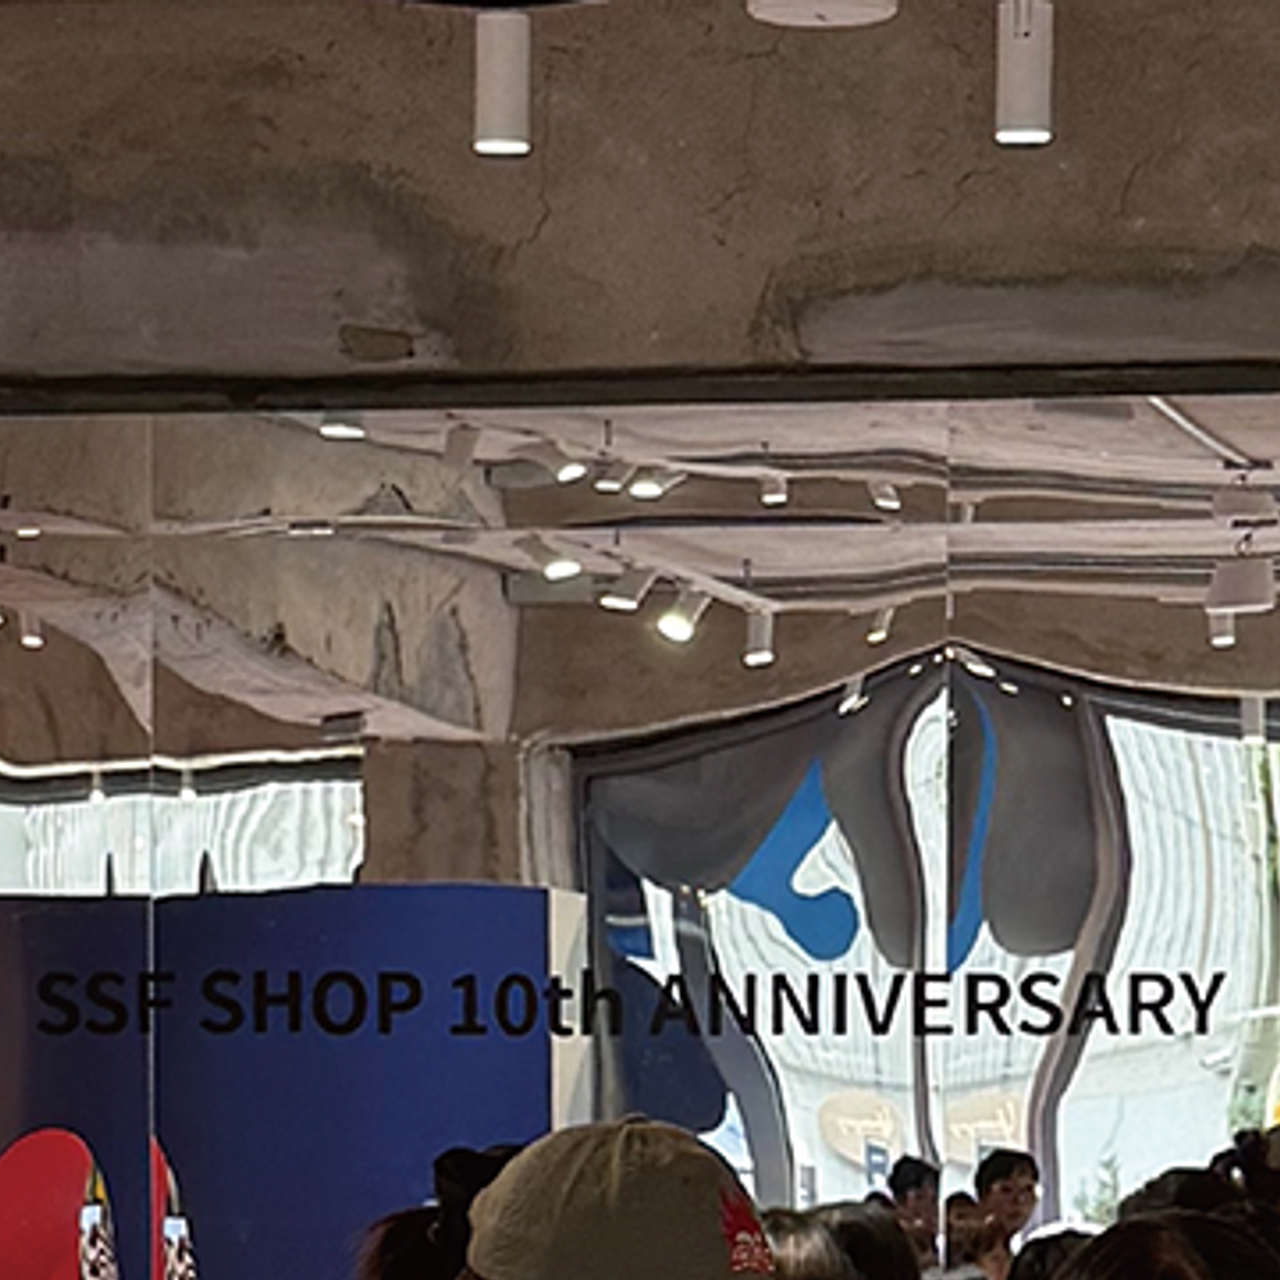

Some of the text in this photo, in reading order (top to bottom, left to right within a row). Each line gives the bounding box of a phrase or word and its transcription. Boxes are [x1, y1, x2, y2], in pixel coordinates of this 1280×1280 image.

[36, 970, 1227, 1037] SSF SHOP 10th ANNIVERSARY
